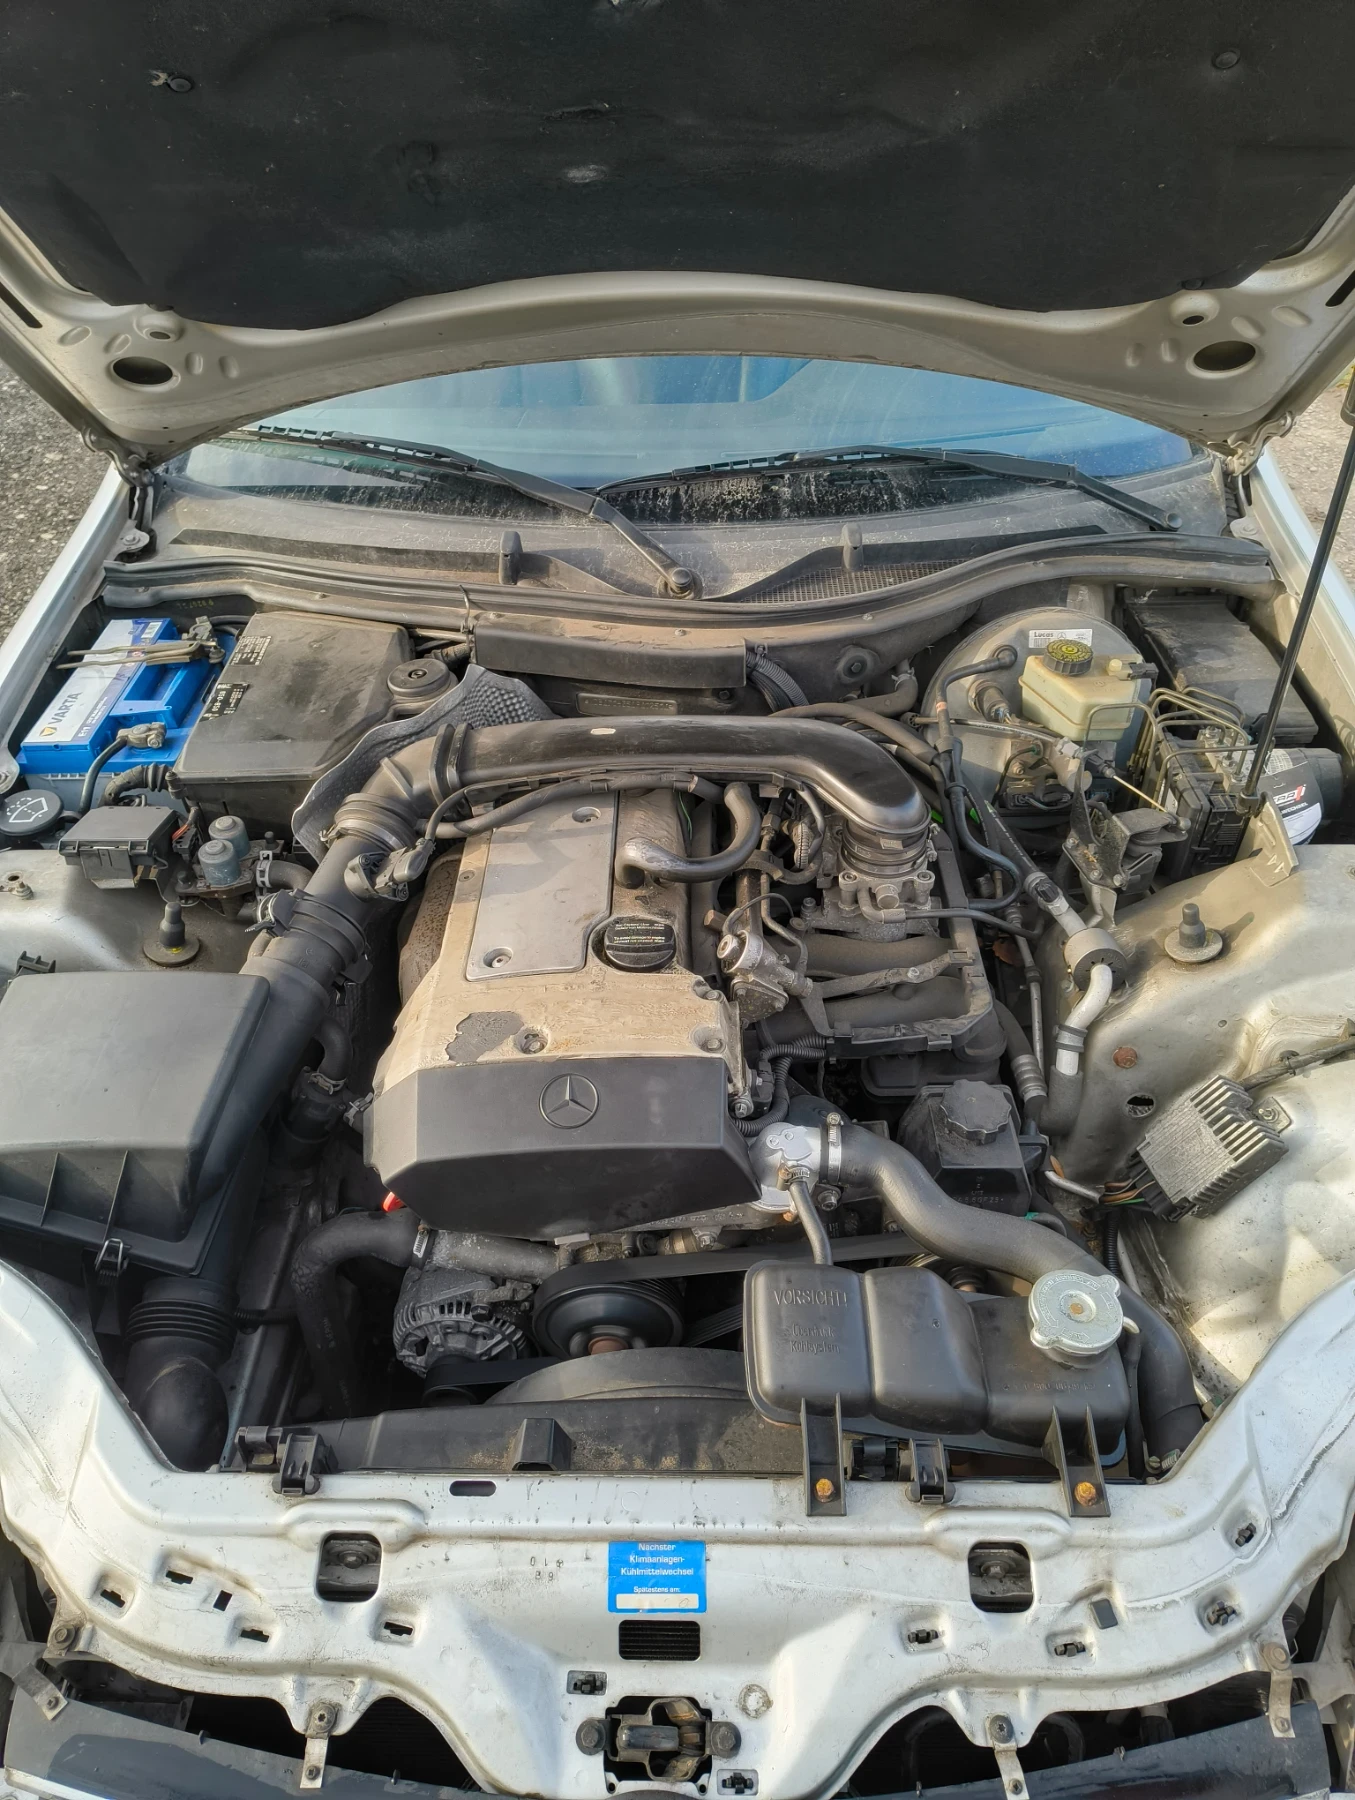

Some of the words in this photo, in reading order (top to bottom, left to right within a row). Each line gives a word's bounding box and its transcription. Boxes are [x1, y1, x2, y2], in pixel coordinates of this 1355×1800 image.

[48, 692, 83, 725] VARTA
[773, 1288, 848, 1308] VORSICHT!
[629, 1555, 685, 1565] Klimaanlagen-
[621, 1567, 694, 1576] Kühlmittelwechsel
